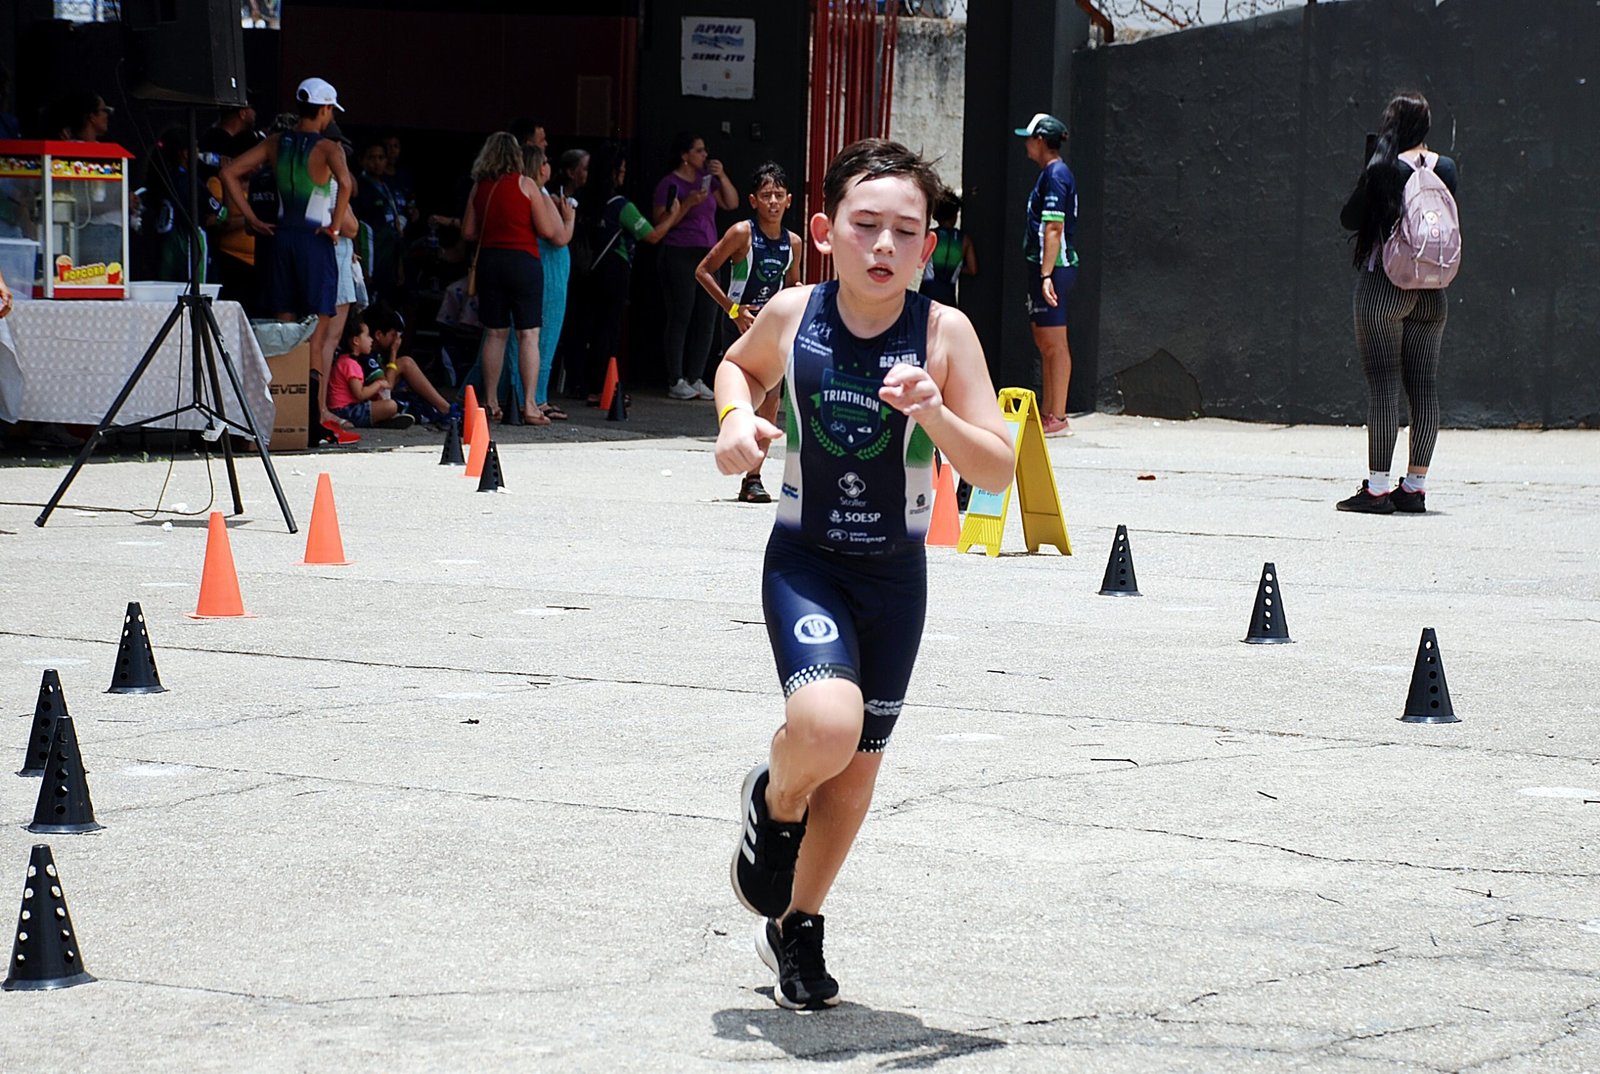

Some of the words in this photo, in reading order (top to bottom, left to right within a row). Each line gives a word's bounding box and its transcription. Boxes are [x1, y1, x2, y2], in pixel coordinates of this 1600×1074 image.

[694, 23, 743, 34] APANI
[691, 52, 745, 62] SEME-ITU
[64, 265, 106, 281] POPCORN
[879, 353, 921, 368] BRASIL
[823, 388, 880, 413] TRIATHLON
[844, 511, 882, 523] SOESP
